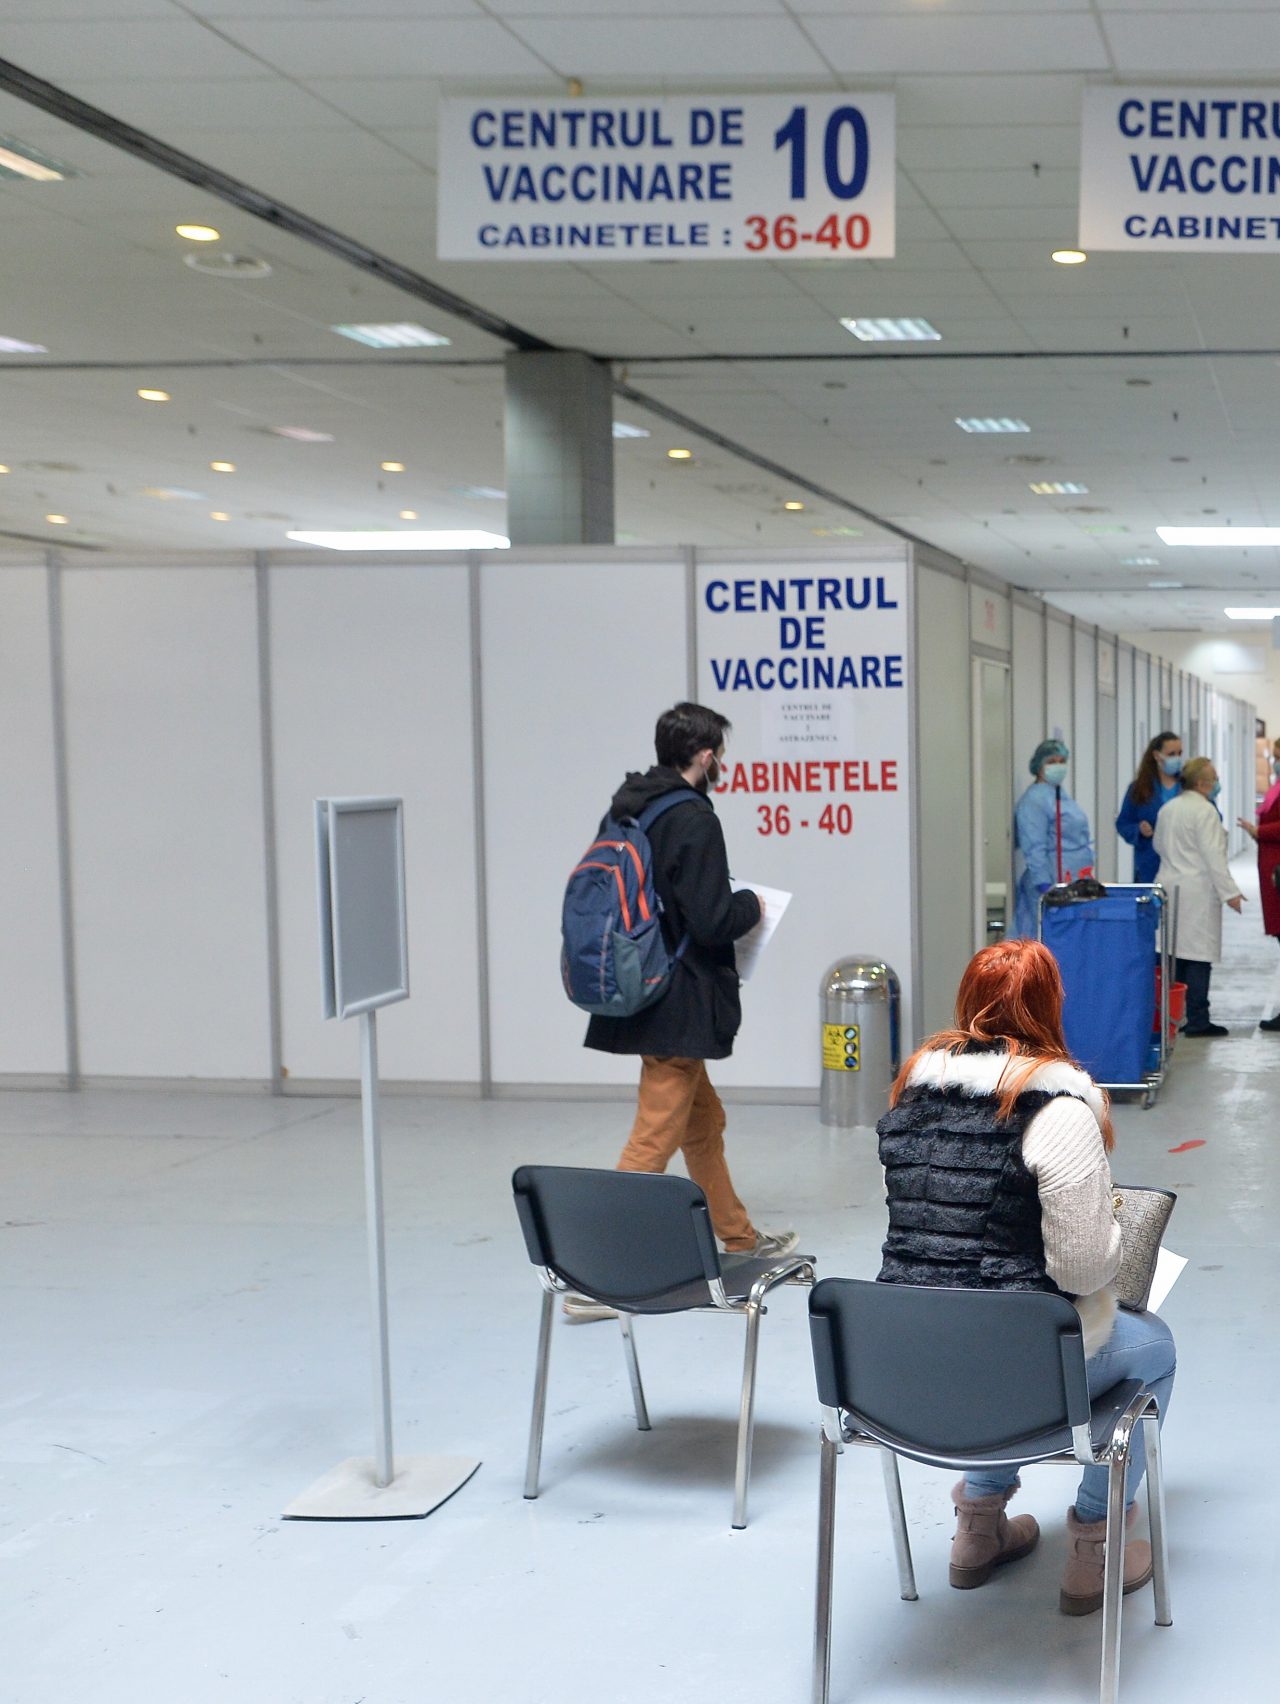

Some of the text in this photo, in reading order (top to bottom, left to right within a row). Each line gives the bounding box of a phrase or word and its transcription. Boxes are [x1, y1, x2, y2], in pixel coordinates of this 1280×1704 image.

[470, 107, 744, 149] CENTRUL DE
[773, 104, 870, 200] 10
[482, 162, 732, 202] VACCINARE
[476, 222, 709, 248] CABINETELE
[744, 212, 871, 252] 36-40
[705, 575, 898, 614] CENTRUL
[779, 616, 826, 651] DE
[710, 654, 904, 691] VACCINARE
[757, 804, 792, 837] 36
[818, 803, 854, 836] 40
